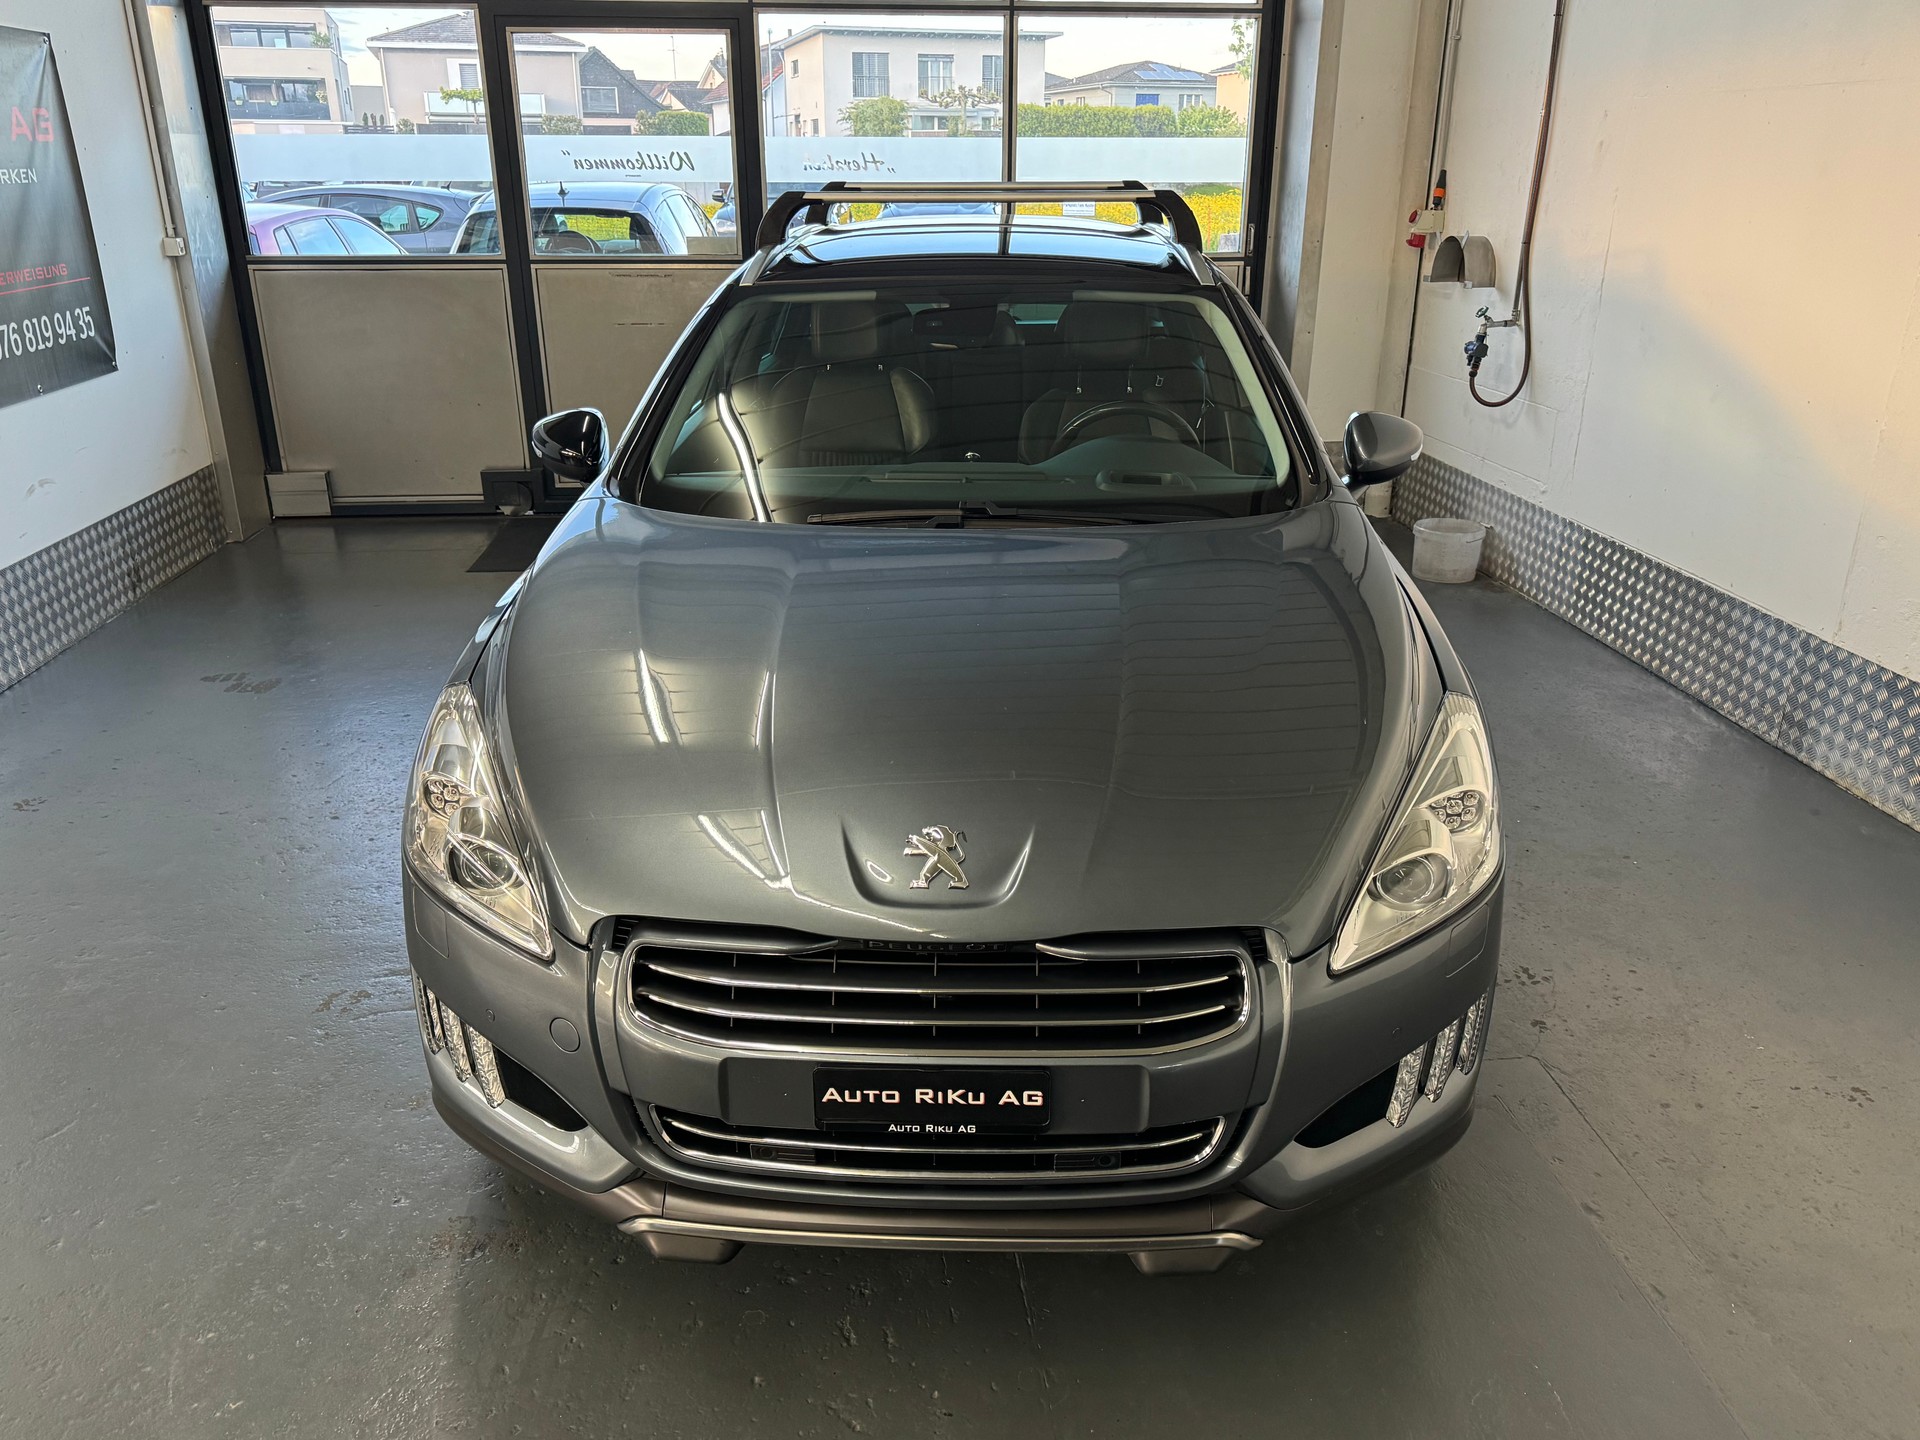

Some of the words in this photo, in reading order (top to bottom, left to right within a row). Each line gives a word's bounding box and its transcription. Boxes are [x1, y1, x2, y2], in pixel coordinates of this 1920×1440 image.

[11, 105, 54, 143] AG
[0, 321, 23, 361] 76
[23, 315, 53, 352] 819
[54, 311, 76, 345] 94
[74, 306, 95, 339] 35
[821, 1087, 900, 1104] AUTO
[915, 1088, 986, 1105] RIKU
[998, 1090, 1044, 1106] AG
[888, 1123, 920, 1133] AUTO
[925, 1124, 953, 1133] RIKU
[957, 1124, 976, 1133] AG
